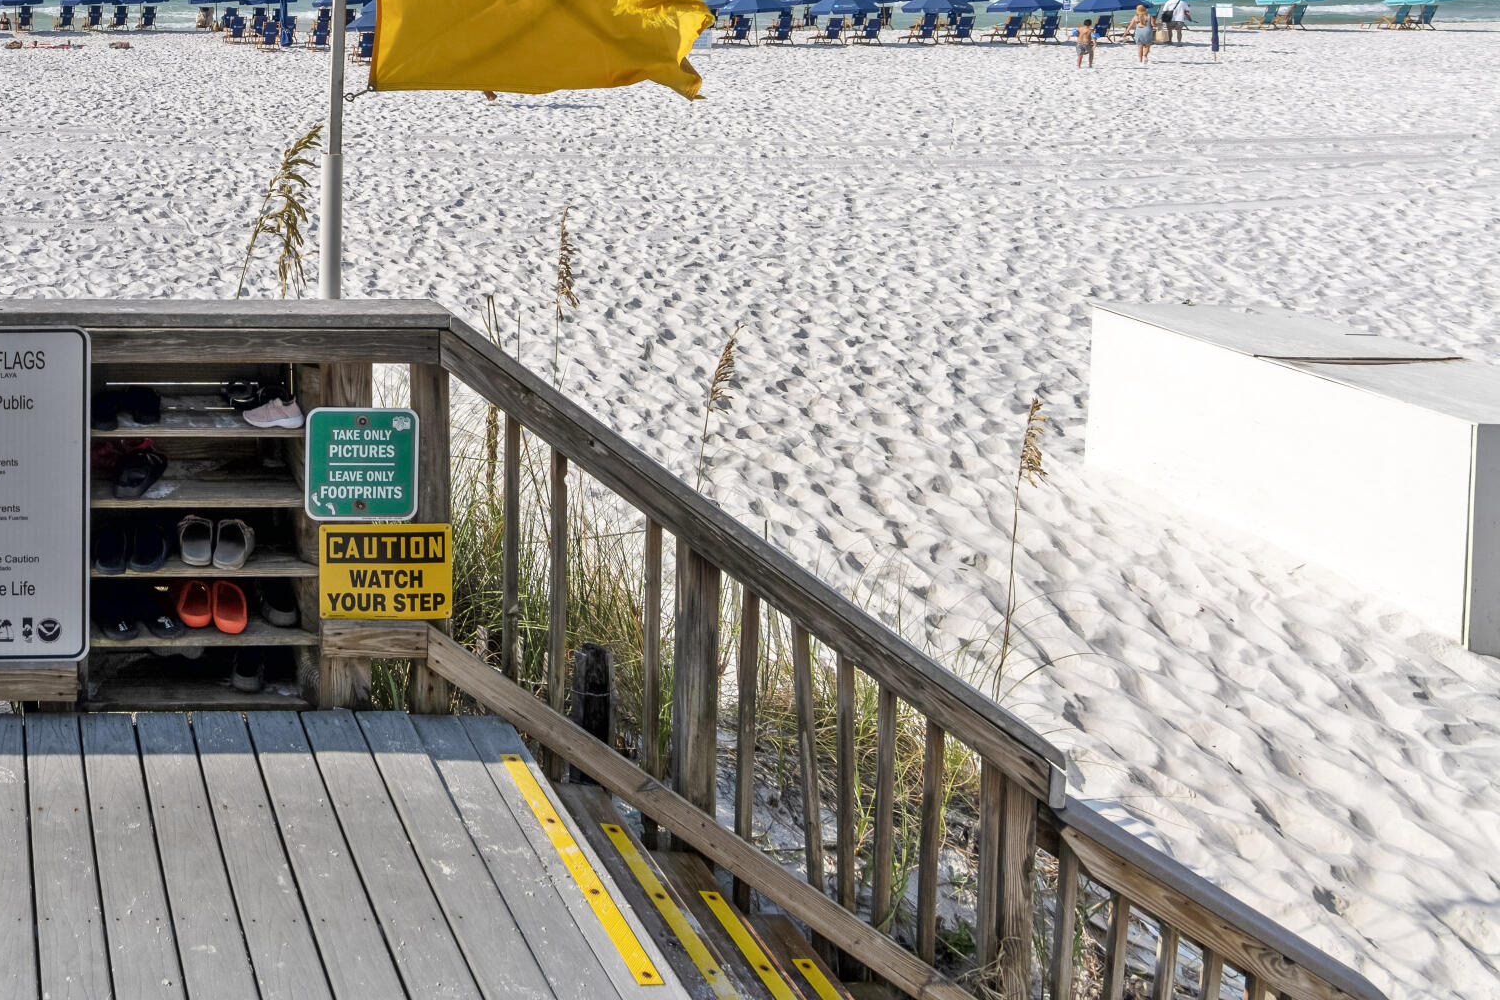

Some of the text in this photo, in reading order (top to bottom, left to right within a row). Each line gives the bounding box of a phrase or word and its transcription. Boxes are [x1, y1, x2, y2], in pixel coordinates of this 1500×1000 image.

[332, 429, 392, 441] TAKE ONLY
[329, 444, 395, 458] PICTURES
[329, 471, 395, 482] LEAVE ONLY
[320, 485, 403, 500] FOOTPRINTS
[329, 536, 443, 559] CAUTION
[4, 554, 40, 564] Caution
[349, 569, 423, 588] WATCH
[11, 581, 36, 596] Life
[327, 593, 446, 613] YOUR STEP
